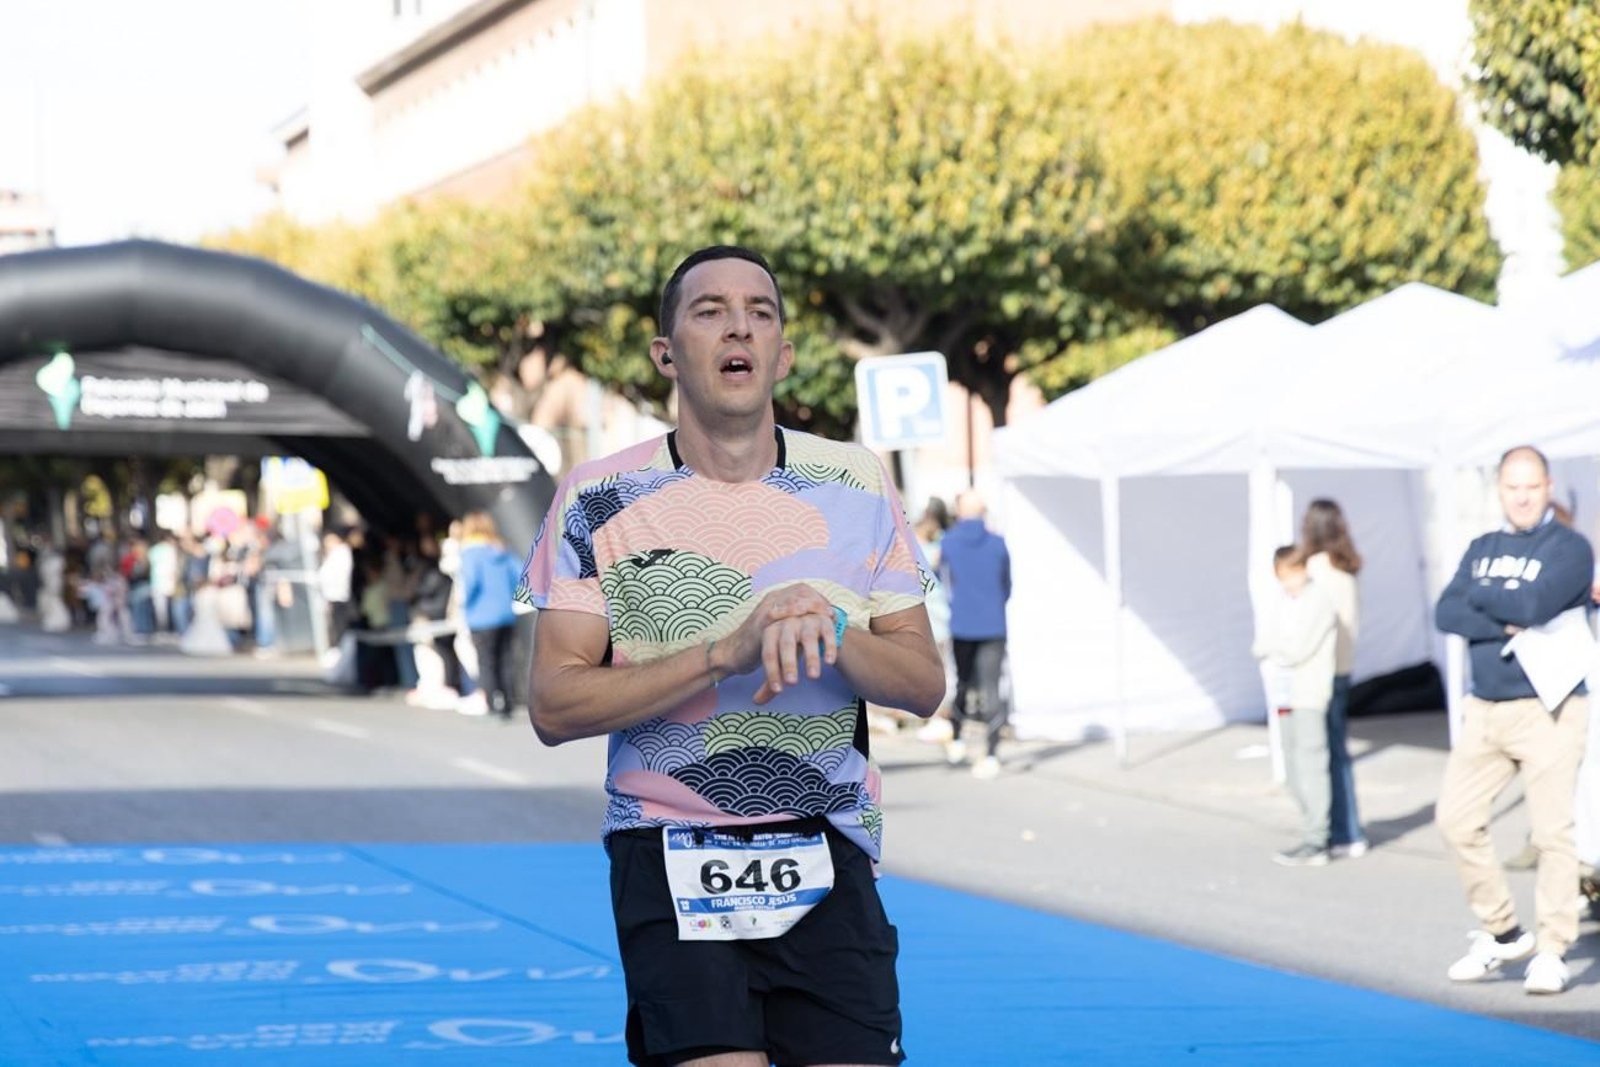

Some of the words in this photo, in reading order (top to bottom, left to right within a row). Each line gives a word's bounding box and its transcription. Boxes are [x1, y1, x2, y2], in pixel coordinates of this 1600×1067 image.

[874, 366, 931, 438] P
[700, 858, 801, 895] 646
[711, 896, 766, 908] FRANCISCO
